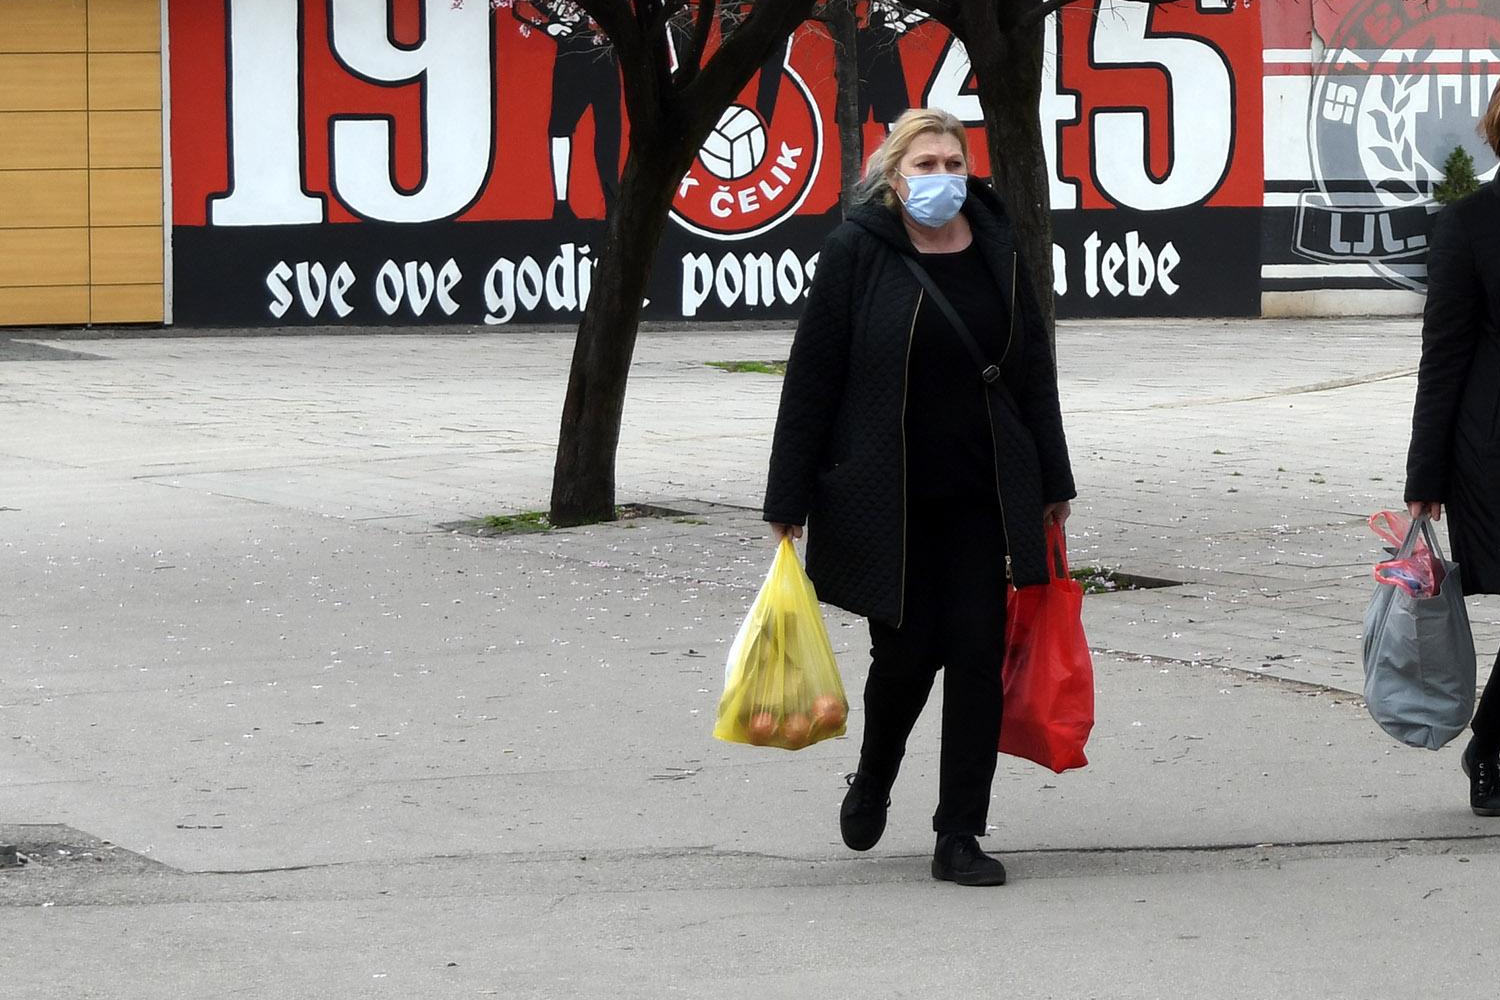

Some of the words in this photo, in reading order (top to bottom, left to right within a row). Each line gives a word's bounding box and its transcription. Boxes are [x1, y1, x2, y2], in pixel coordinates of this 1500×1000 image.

[710, 141, 803, 218] ČELIK
[266, 260, 356, 318] sve
[376, 257, 463, 316] ove
[483, 242, 650, 325] godi
[682, 249, 820, 317] ponos
[1083, 230, 1181, 298] tebe
